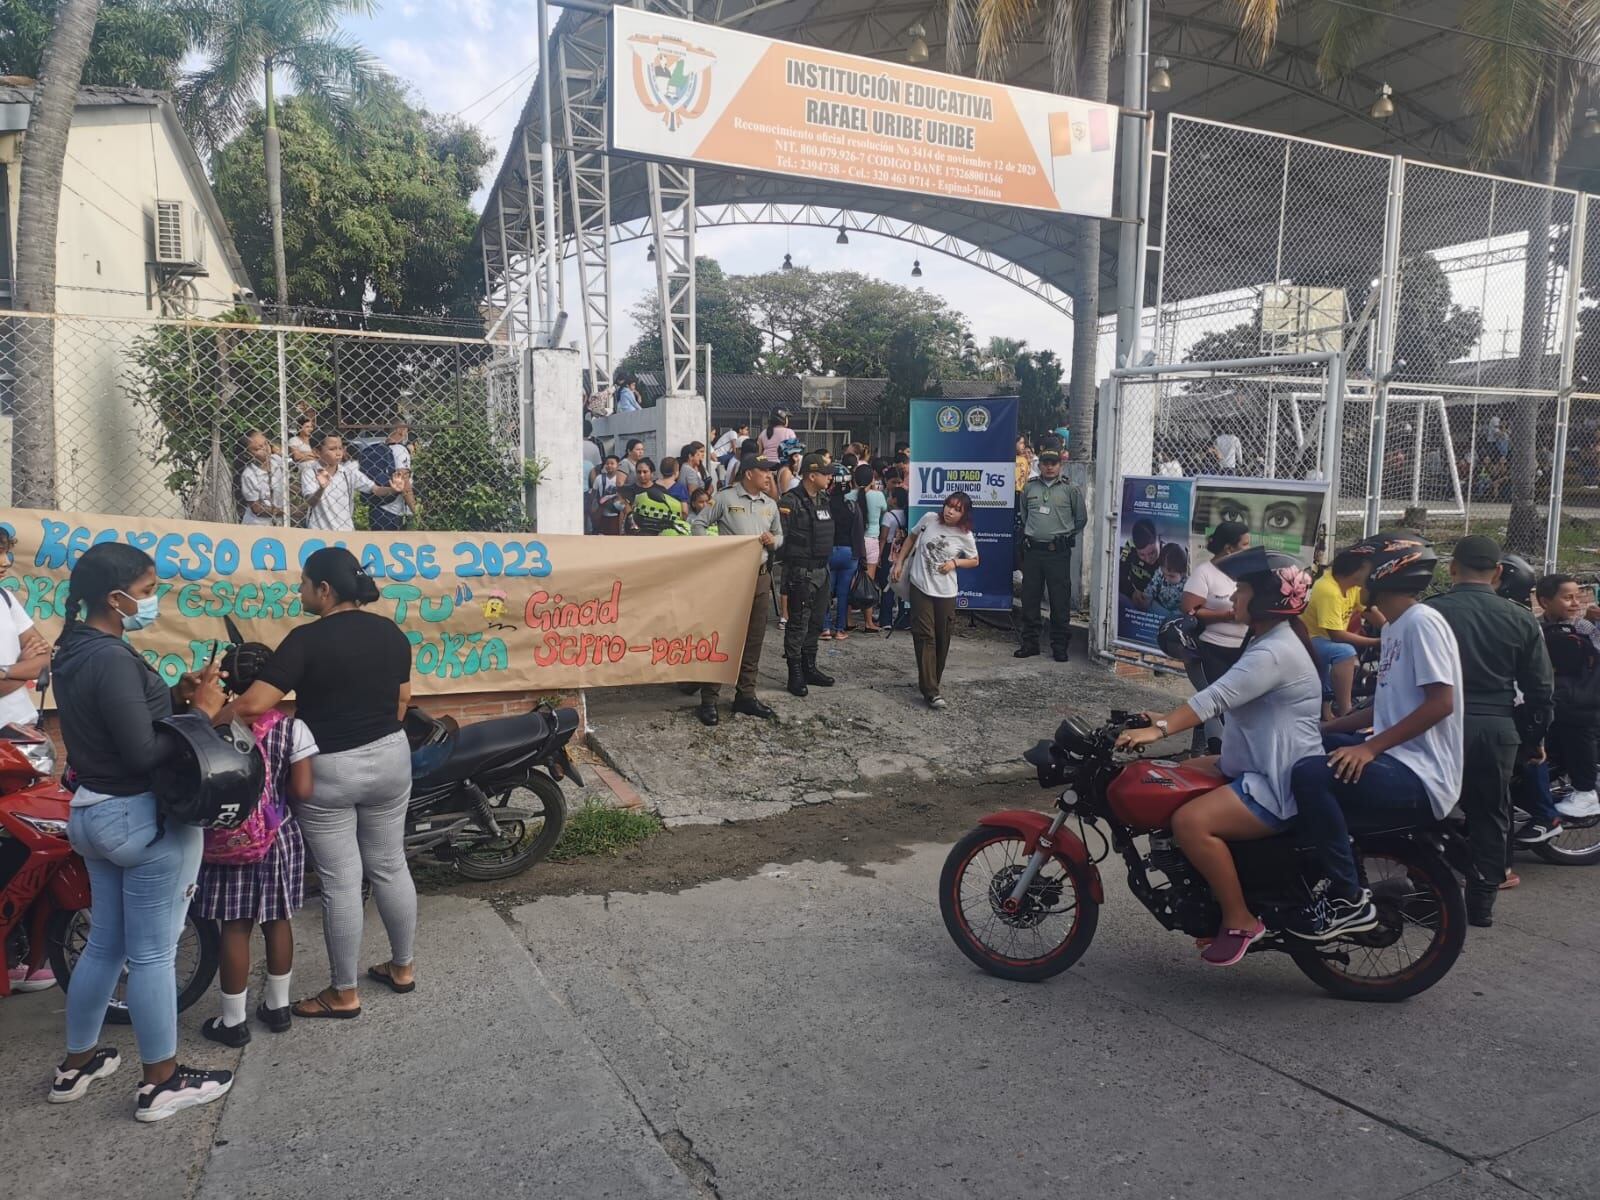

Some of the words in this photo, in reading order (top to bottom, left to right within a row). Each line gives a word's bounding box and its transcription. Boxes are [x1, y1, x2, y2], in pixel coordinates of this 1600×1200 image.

[786, 58, 900, 103] INSTITUCIÓN
[904, 82, 993, 121] EDUCATIVA
[806, 99, 868, 132] RAFAEL
[873, 111, 923, 141] URIBE
[926, 120, 975, 150] URIBE
[734, 117, 814, 141] Reconocimiento
[817, 131, 846, 146] oficial
[847, 136, 894, 152] resolución
[896, 143, 910, 155] No
[912, 146, 933, 159] 3414
[934, 150, 946, 162] de
[946, 152, 992, 169] noviembre
[994, 158, 1003, 170] 12
[1005, 161, 1016, 172] de
[1018, 162, 1037, 176] 2020
[776, 140, 798, 153] NIT.
[800, 144, 865, 162] 800.079.926-7
[867, 154, 912, 170] CODIGO
[914, 161, 945, 175] DANE
[776, 155, 798, 168] Tel.:
[800, 158, 840, 174] 2394738
[848, 165, 871, 179] Cel.:
[872, 169, 889, 182] 320
[890, 172, 907, 185] 463
[909, 175, 930, 189] 0714
[938, 179, 1002, 199] Espinal-Tolima
[918, 467, 945, 494] YO
[946, 483, 981, 492] DENUNCIO
[947, 471, 958, 480] NO
[961, 471, 980, 480] PAGO
[985, 473, 1005, 487] 165
[251, 537, 287, 571] A
[454, 540, 552, 577] 2023
